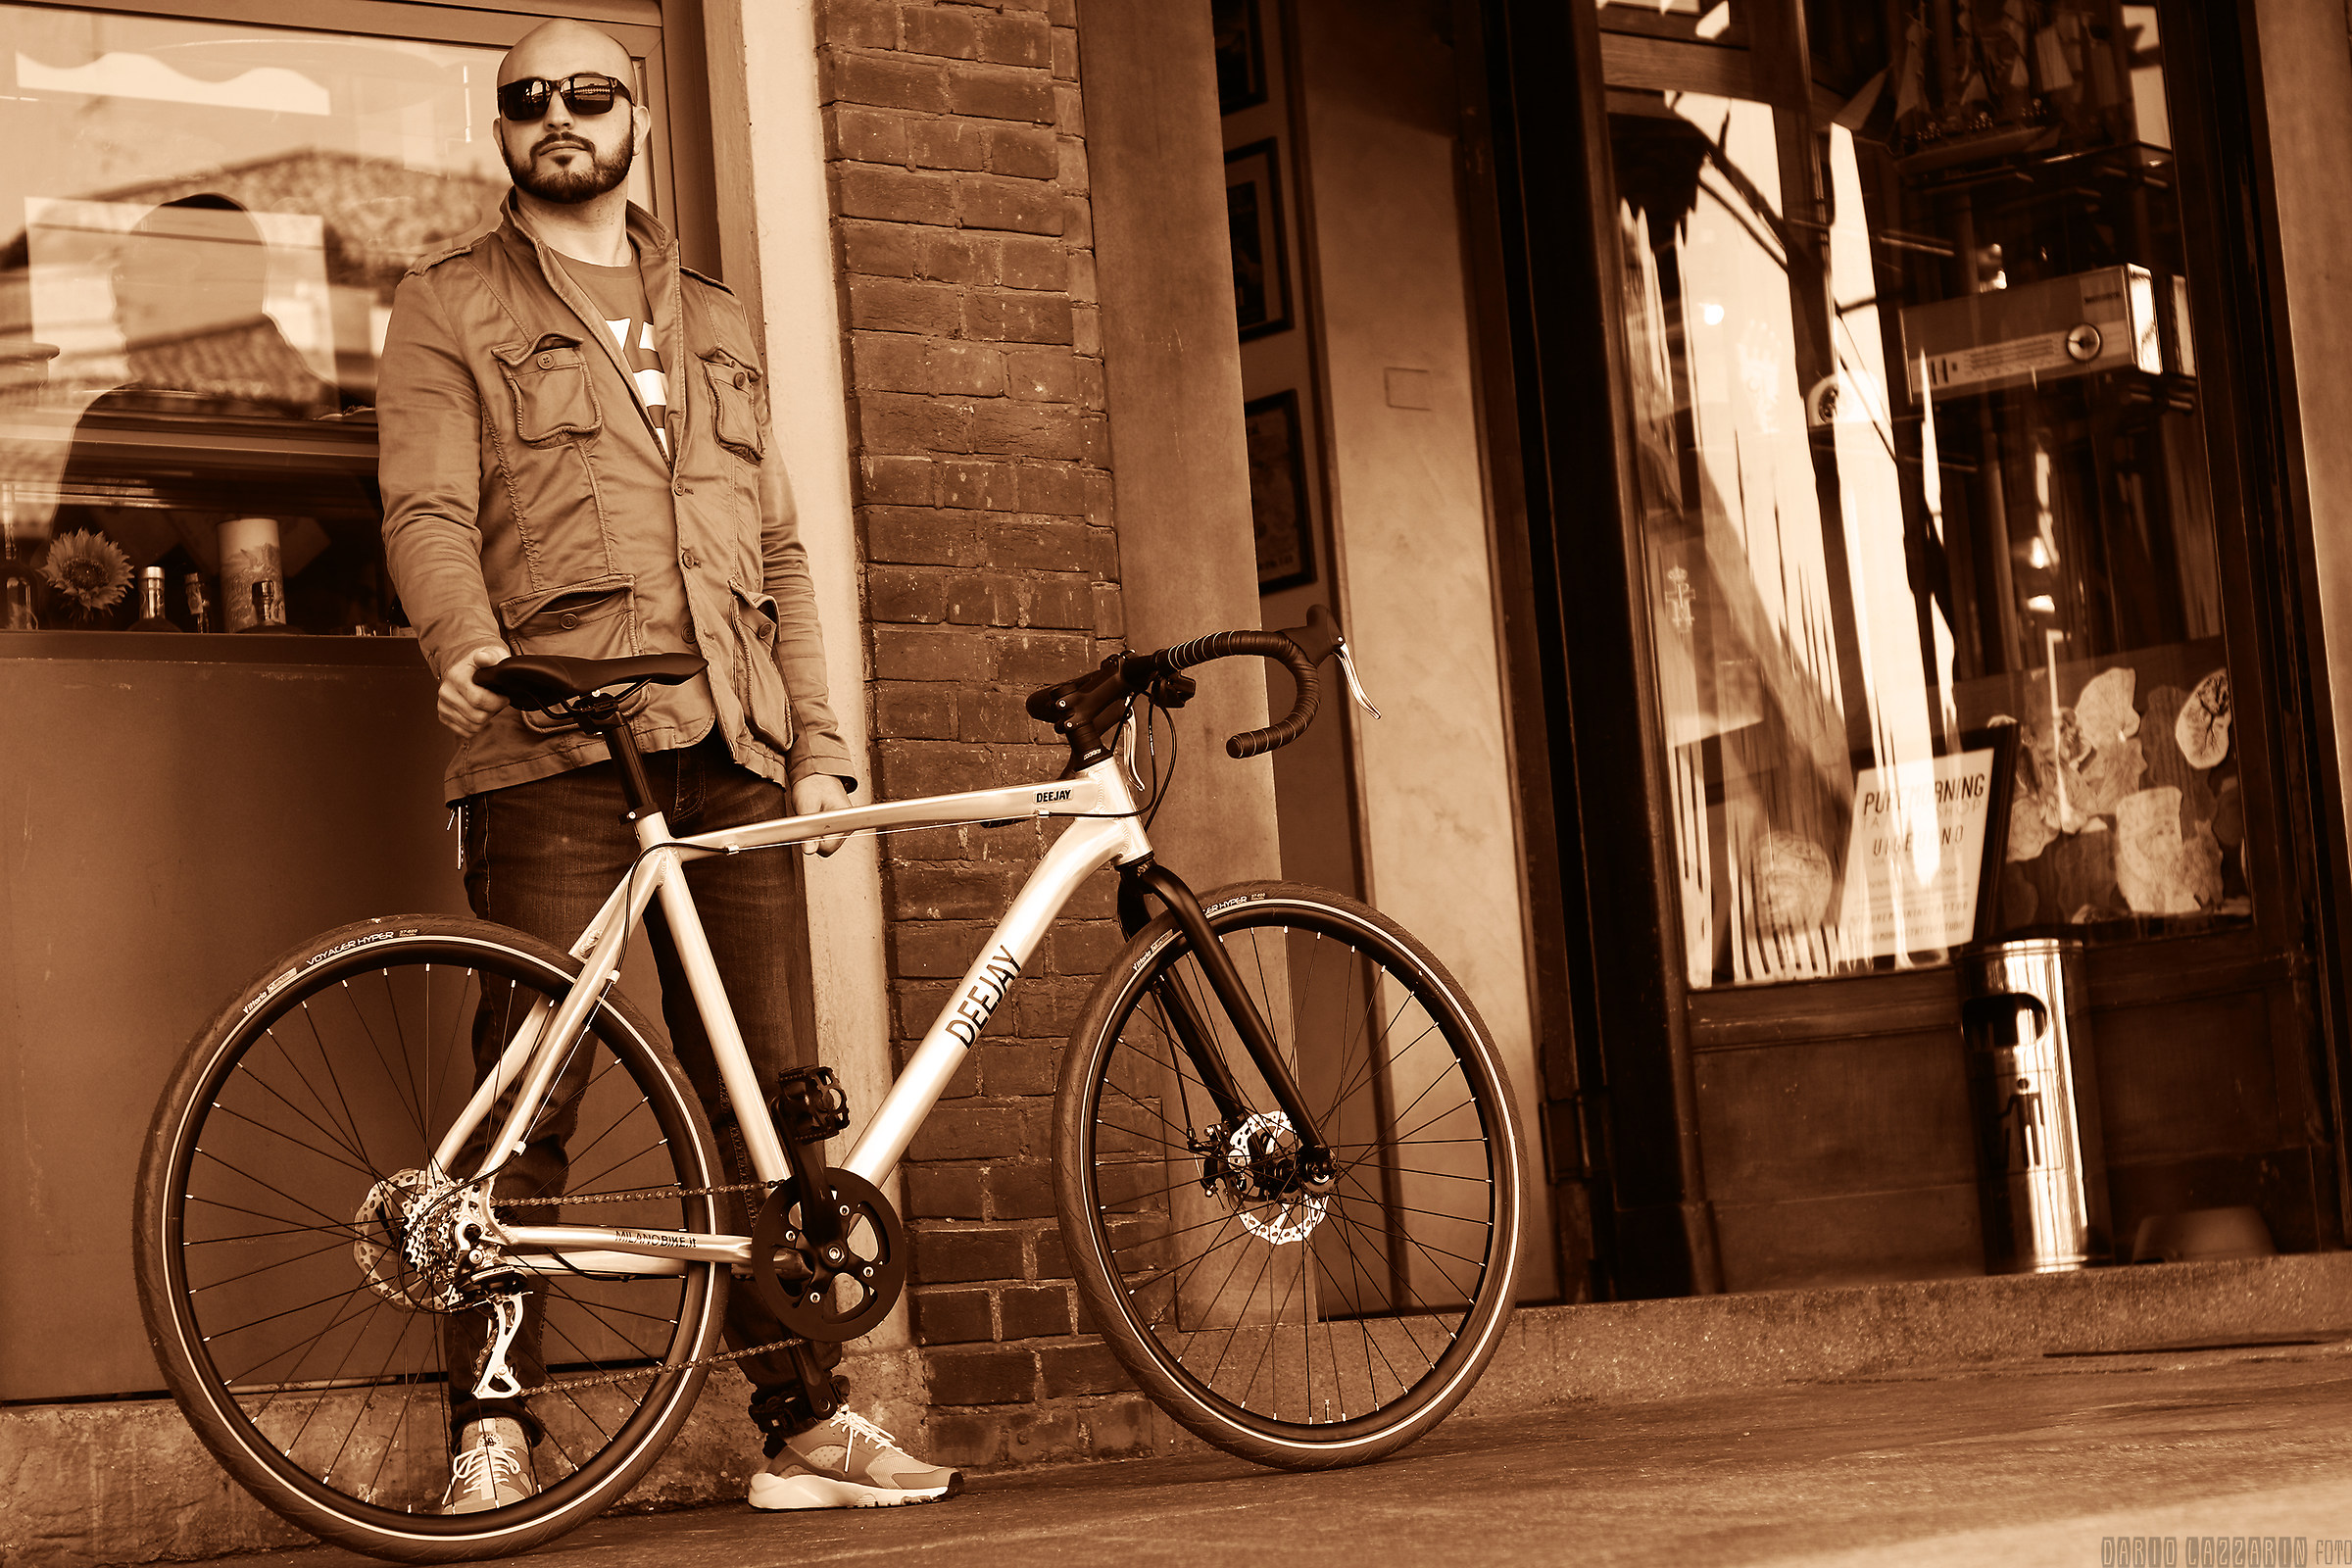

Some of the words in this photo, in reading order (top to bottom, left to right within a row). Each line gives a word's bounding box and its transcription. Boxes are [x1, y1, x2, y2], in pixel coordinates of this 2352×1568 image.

[1036, 789, 1072, 804] DEEJAY
[1219, 896, 1248, 909] HYPER
[306, 940, 357, 965] VOYAGER
[357, 931, 395, 946] HYPER
[242, 991, 268, 1014] Vittoria
[945, 944, 1022, 1051] DEEJAY
[614, 1230, 698, 1249] MILANOBIKE.it
